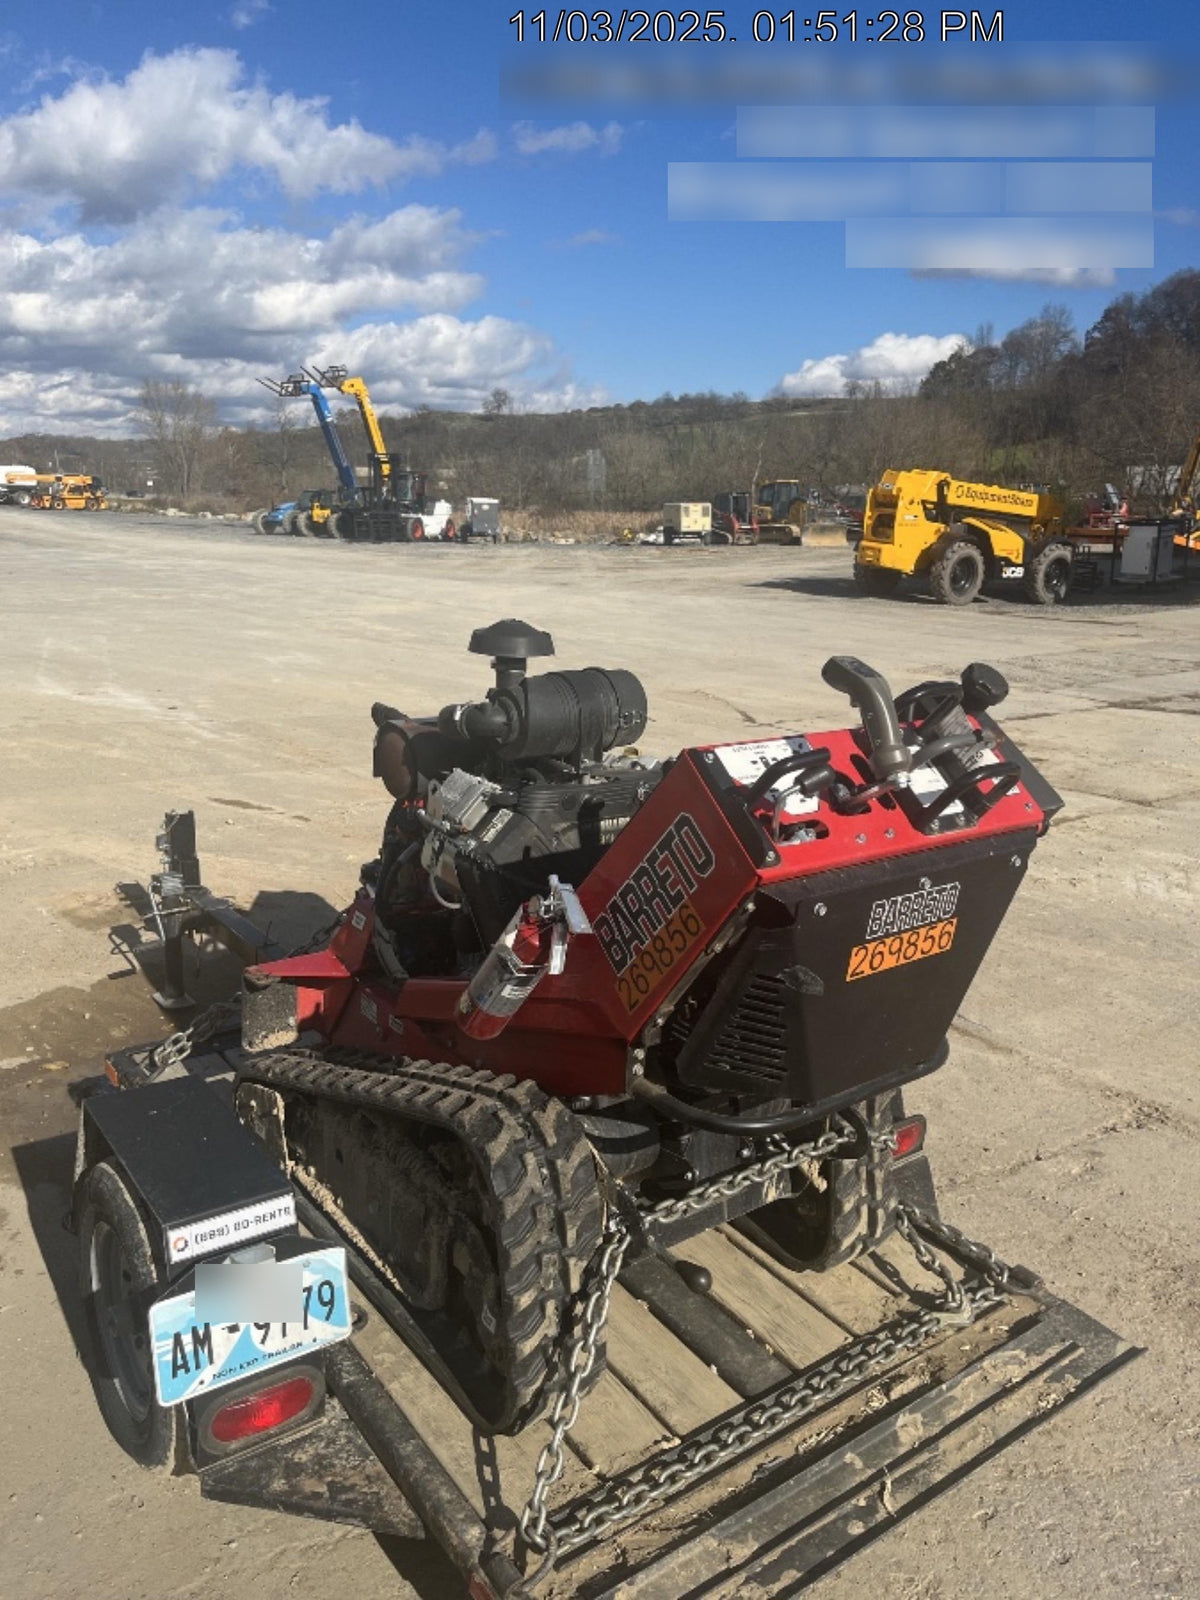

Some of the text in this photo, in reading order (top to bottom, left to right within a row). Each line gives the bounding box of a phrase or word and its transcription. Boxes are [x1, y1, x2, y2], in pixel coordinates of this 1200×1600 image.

[591, 811, 716, 977] BARRETO
[865, 882, 961, 939] BARRETO
[617, 904, 700, 1011] 269856
[849, 920, 954, 978] 269856
